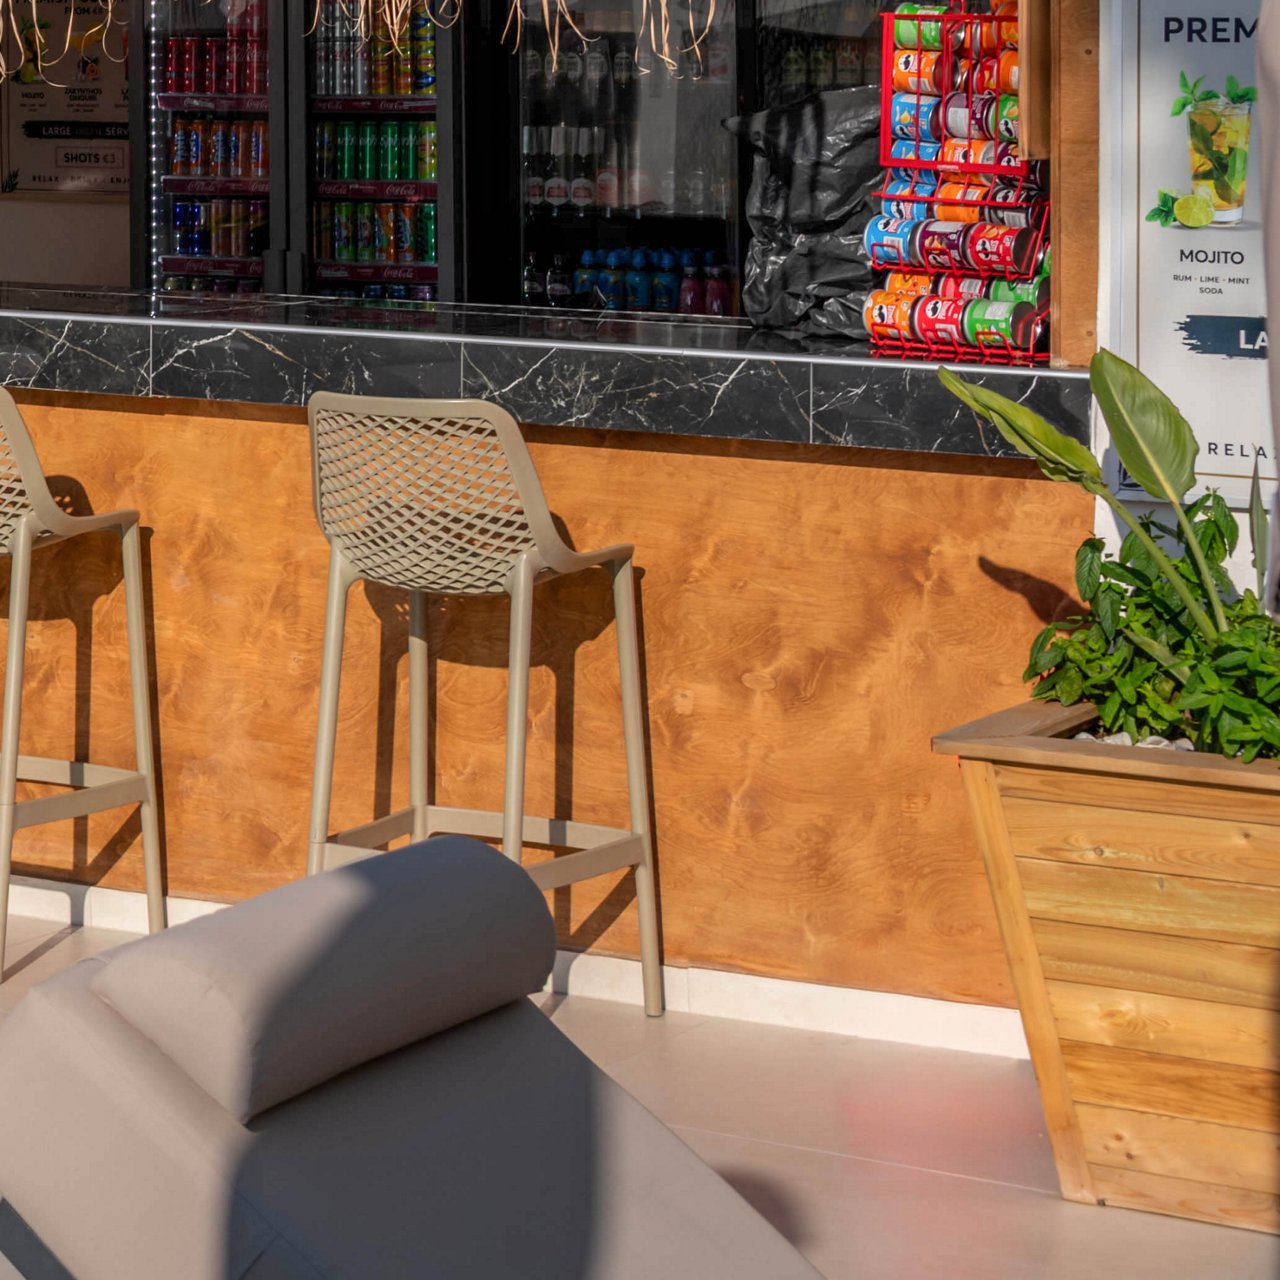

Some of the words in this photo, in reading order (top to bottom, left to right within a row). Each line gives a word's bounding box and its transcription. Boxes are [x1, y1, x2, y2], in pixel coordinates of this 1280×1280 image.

[63, 152, 100, 164] SHOTS
[1179, 248, 1245, 265] MOJITO
[1173, 274, 1192, 282] RUM
[1199, 275, 1220, 284] LIME
[1228, 277, 1251, 286] MINT
[1199, 286, 1224, 295] SODA
[1207, 441, 1278, 461] RELA
